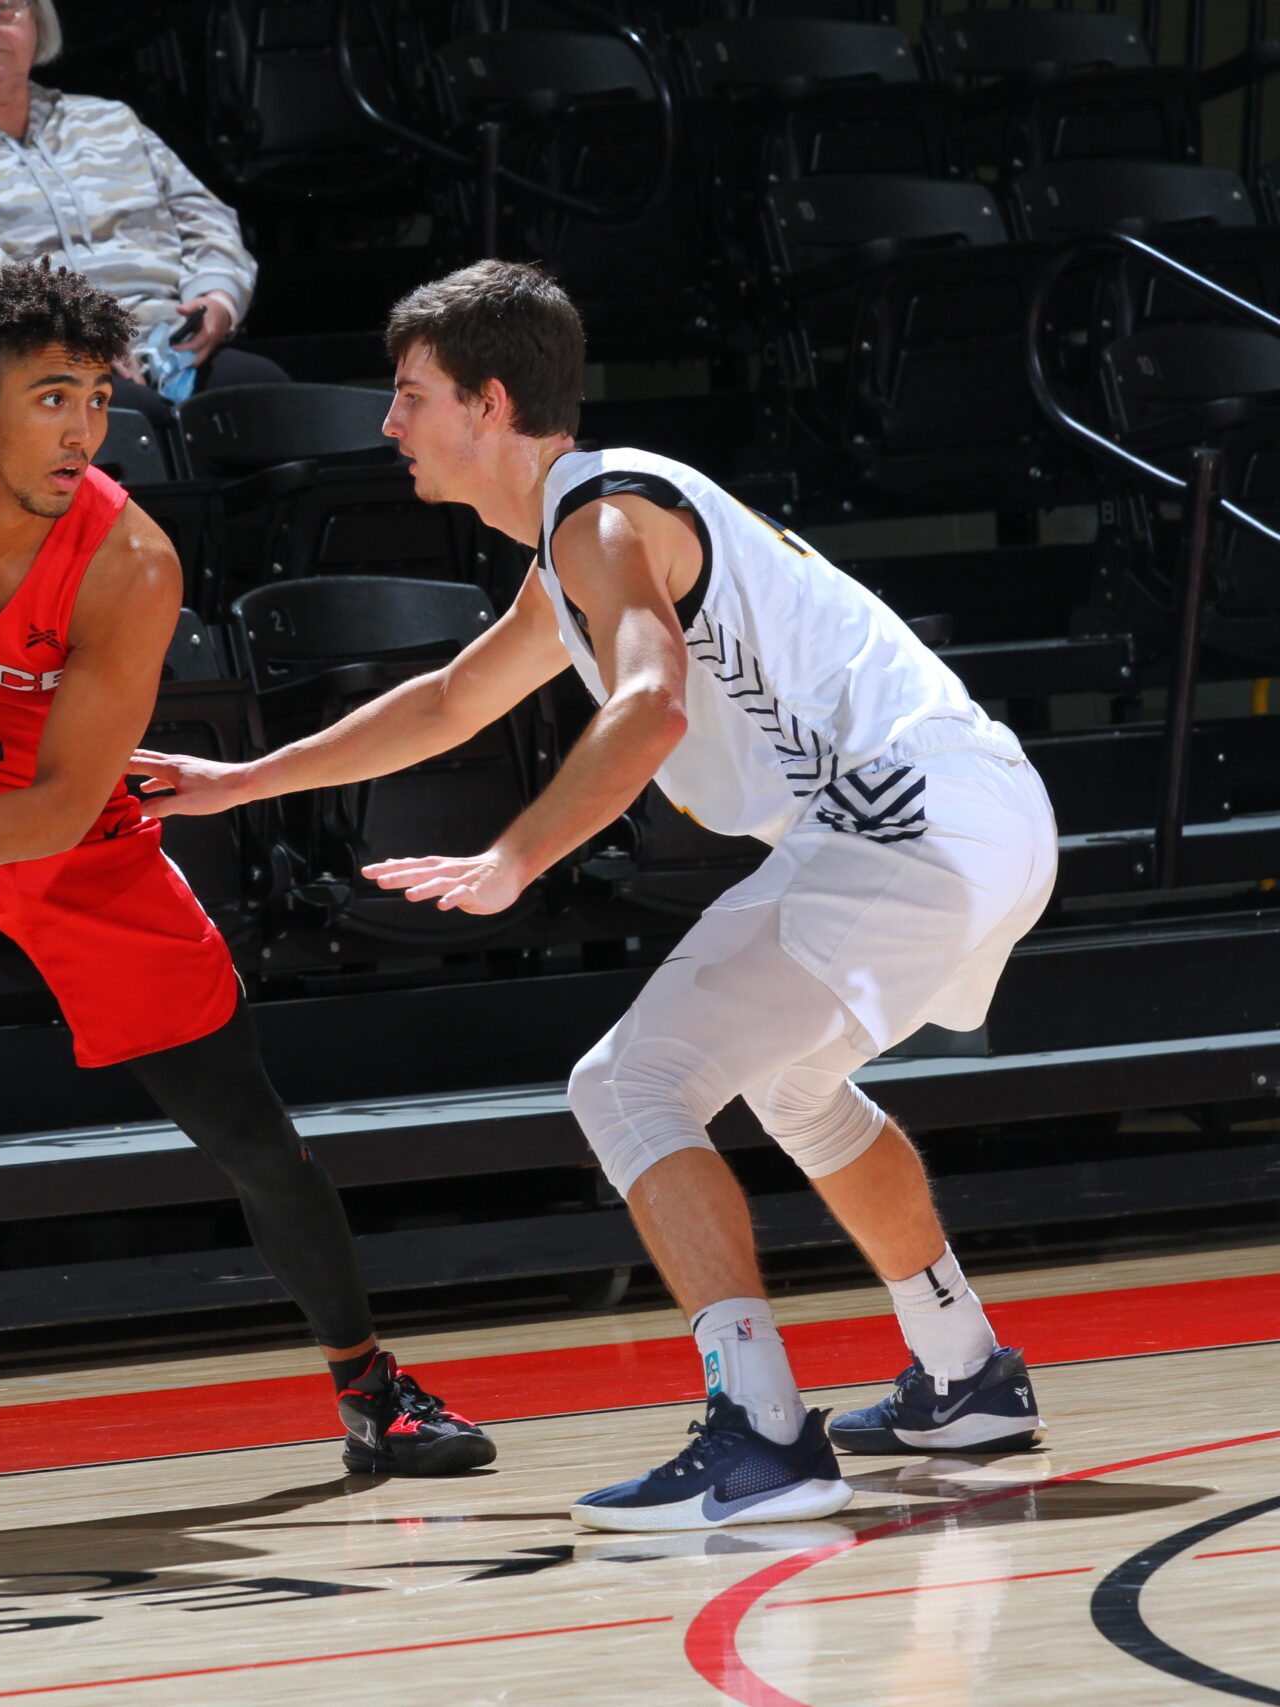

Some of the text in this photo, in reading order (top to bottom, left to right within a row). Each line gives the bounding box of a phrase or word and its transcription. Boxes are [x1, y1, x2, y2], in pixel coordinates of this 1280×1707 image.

[211, 413, 225, 435] 1
[1101, 499, 1116, 525] B
[270, 609, 286, 632] 2
